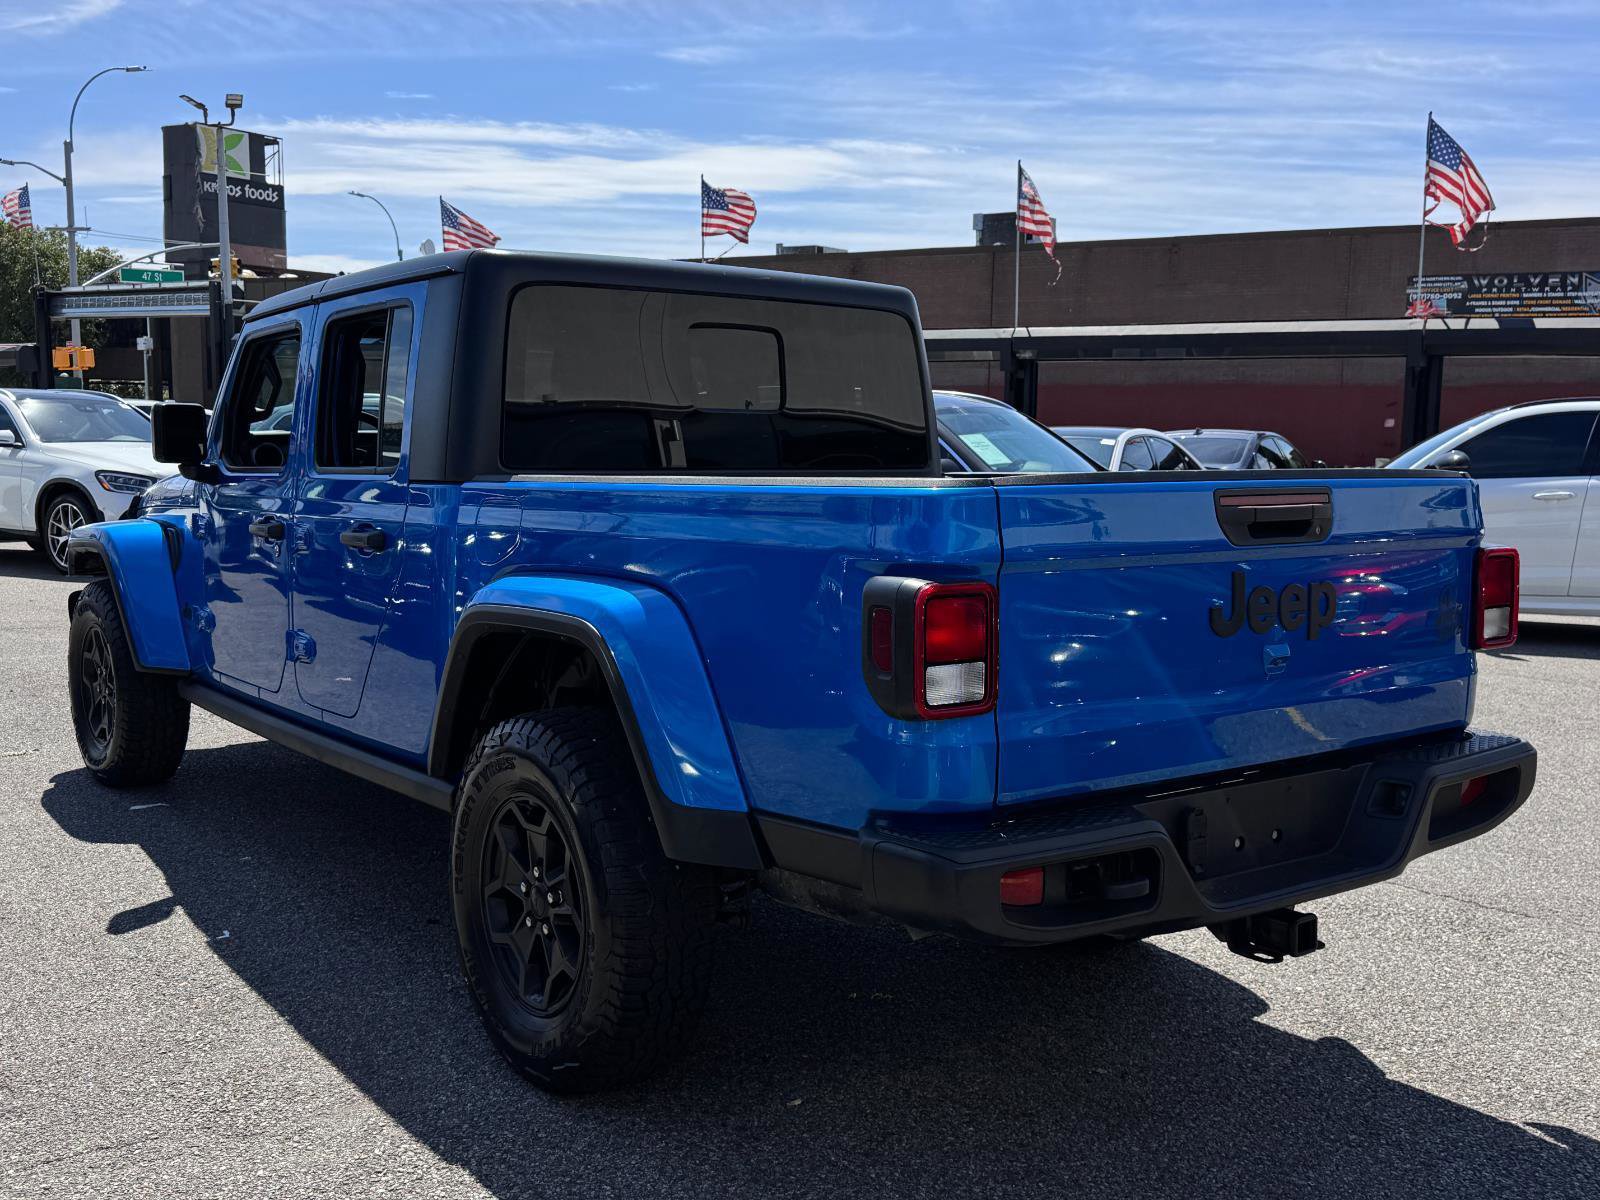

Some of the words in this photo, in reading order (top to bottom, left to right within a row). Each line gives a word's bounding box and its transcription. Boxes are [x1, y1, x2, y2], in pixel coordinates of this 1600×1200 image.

[244, 184, 280, 203] foods
[142, 271, 152, 281] 47
[154, 272, 163, 282] St
[1472, 274, 1579, 287] WOLVEN
[1208, 570, 1337, 641] Jeep
